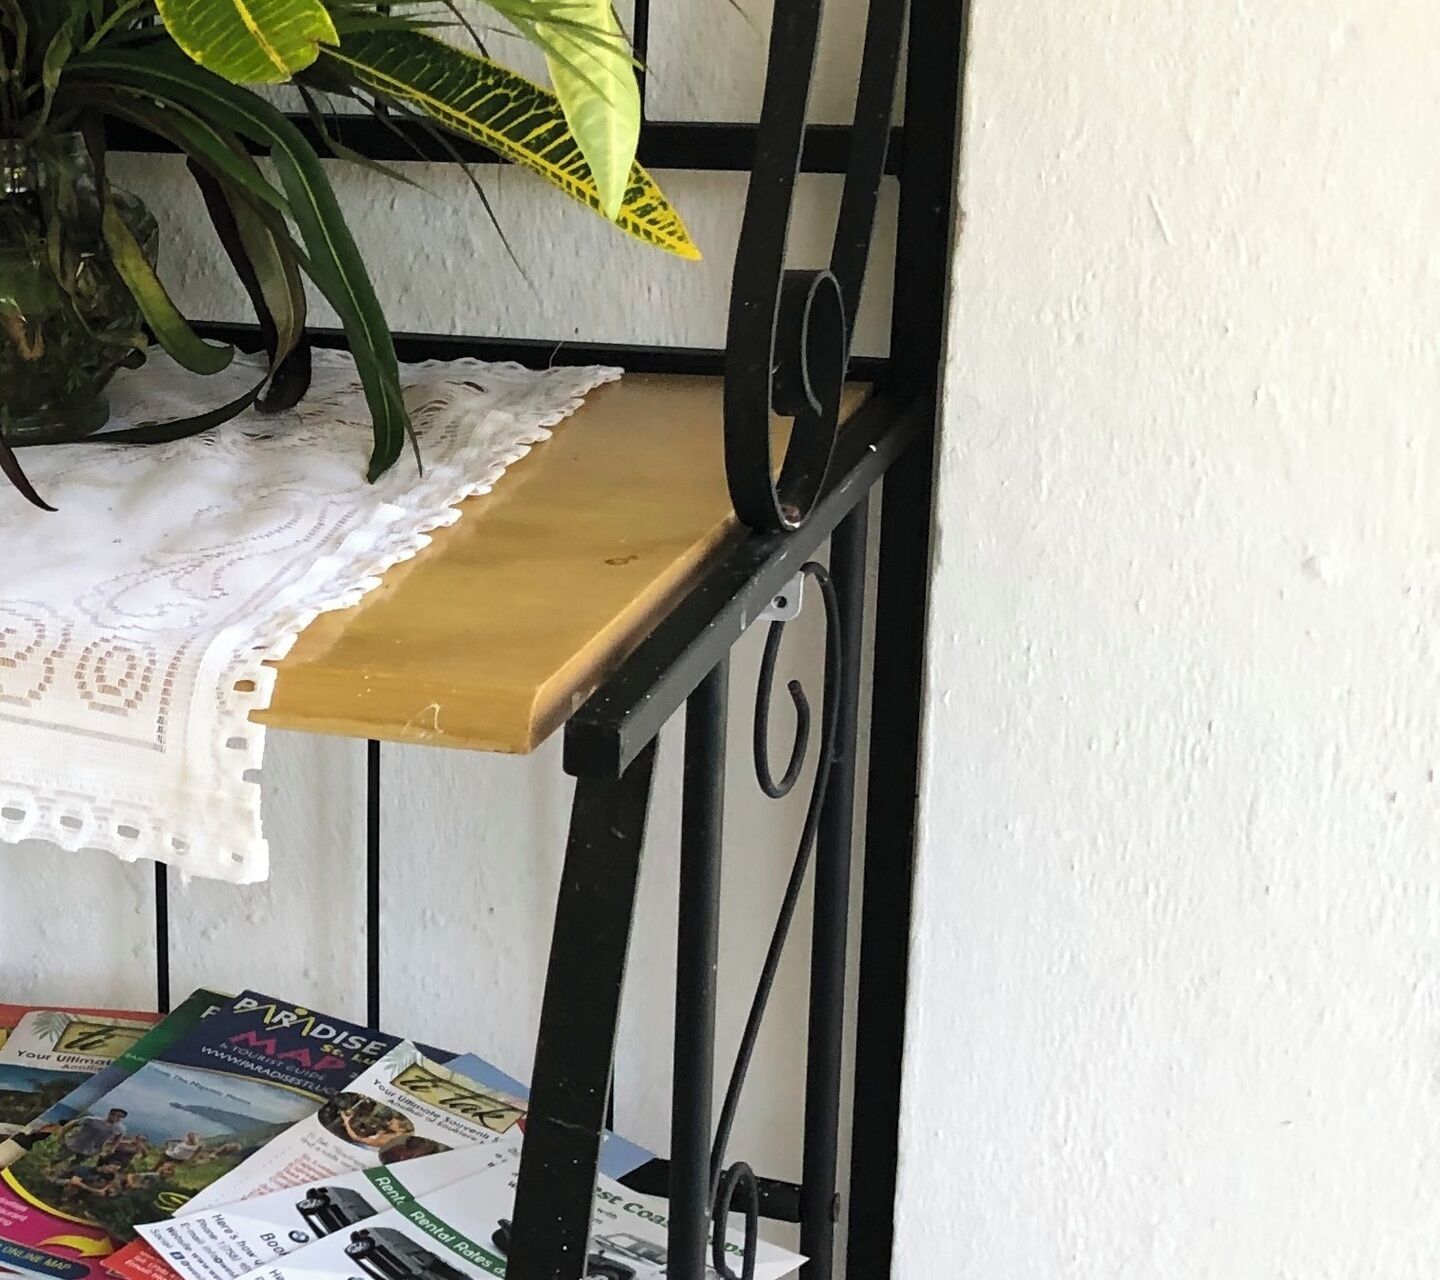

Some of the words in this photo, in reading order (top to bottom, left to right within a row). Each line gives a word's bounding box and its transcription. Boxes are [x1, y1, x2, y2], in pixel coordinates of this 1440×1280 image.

[200, 1005, 221, 1019] F
[232, 996, 388, 1056] PARADISE
[16, 1049, 52, 1062] Your
[55, 1051, 112, 1066] Ultimat
[227, 1029, 347, 1071] MAP
[231, 1044, 284, 1069] TOURIST
[351, 1053, 378, 1066] Lu
[372, 1077, 396, 1098] Your
[397, 1093, 442, 1120] Ultimate
[374, 1175, 406, 1208] Rent
[236, 1239, 261, 1262] how
[409, 1210, 457, 1244] Rental
[452, 1239, 493, 1269] Rates
[43, 1257, 73, 1272] MAP
